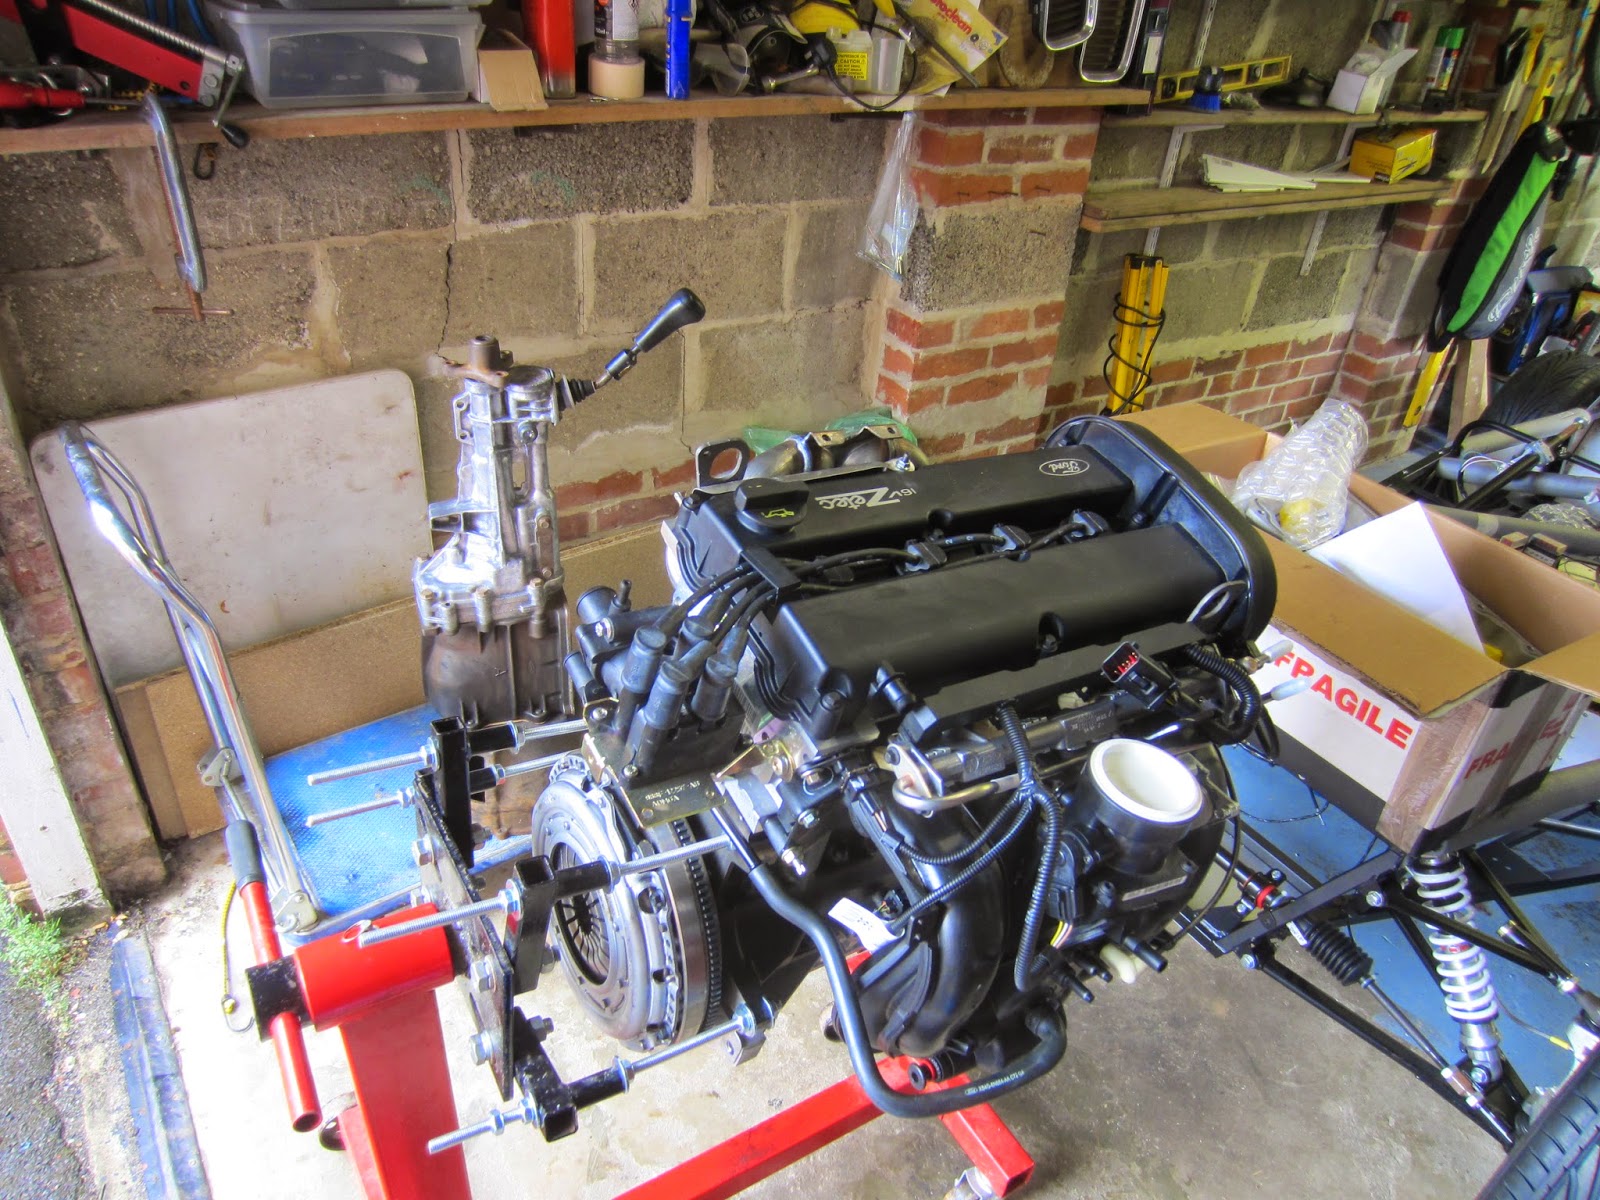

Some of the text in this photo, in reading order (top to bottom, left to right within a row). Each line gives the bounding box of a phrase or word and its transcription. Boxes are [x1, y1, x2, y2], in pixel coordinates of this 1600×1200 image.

[1048, 461, 1081, 474] Ford
[814, 487, 917, 510] 16V Zetec
[1274, 652, 1413, 750] FRAGILE
